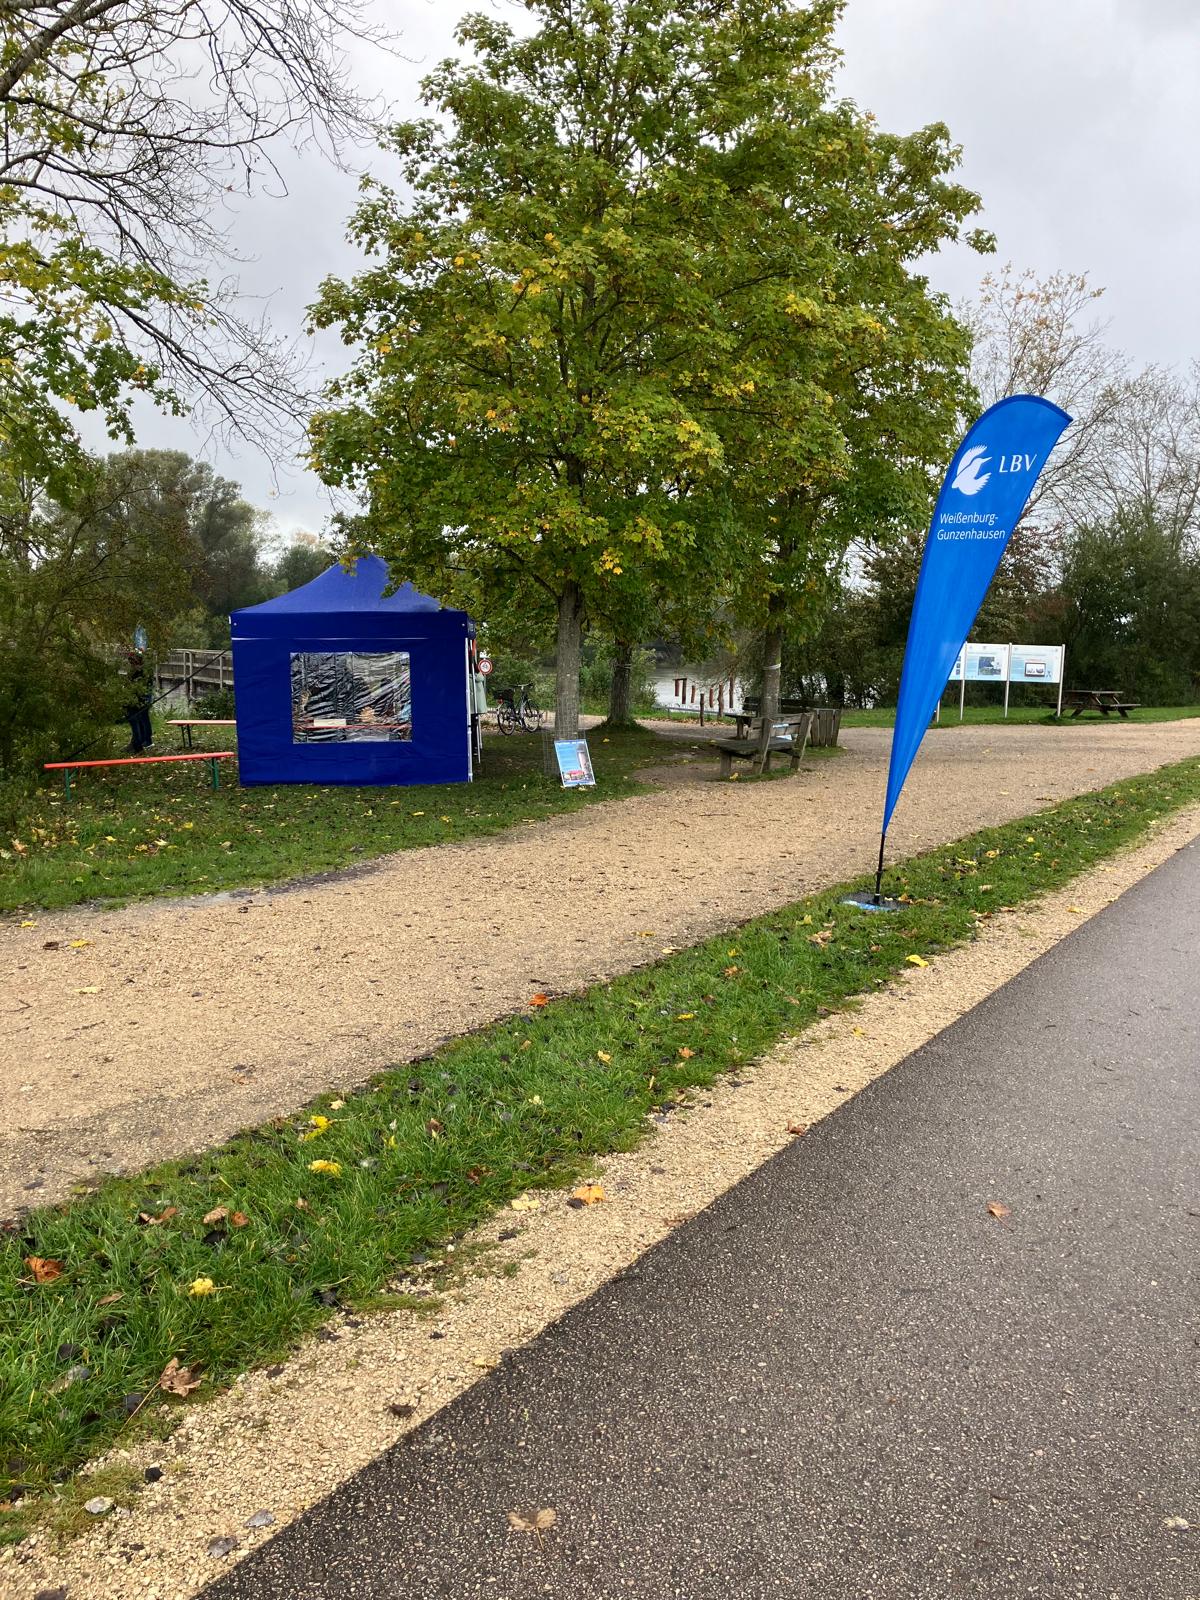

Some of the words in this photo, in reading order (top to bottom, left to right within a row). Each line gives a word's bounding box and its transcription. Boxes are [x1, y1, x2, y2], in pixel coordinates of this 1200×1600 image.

[999, 454, 1037, 473] LBV
[940, 512, 998, 525] Weißenburg-
[937, 528, 1005, 541] Gunzenhausen
